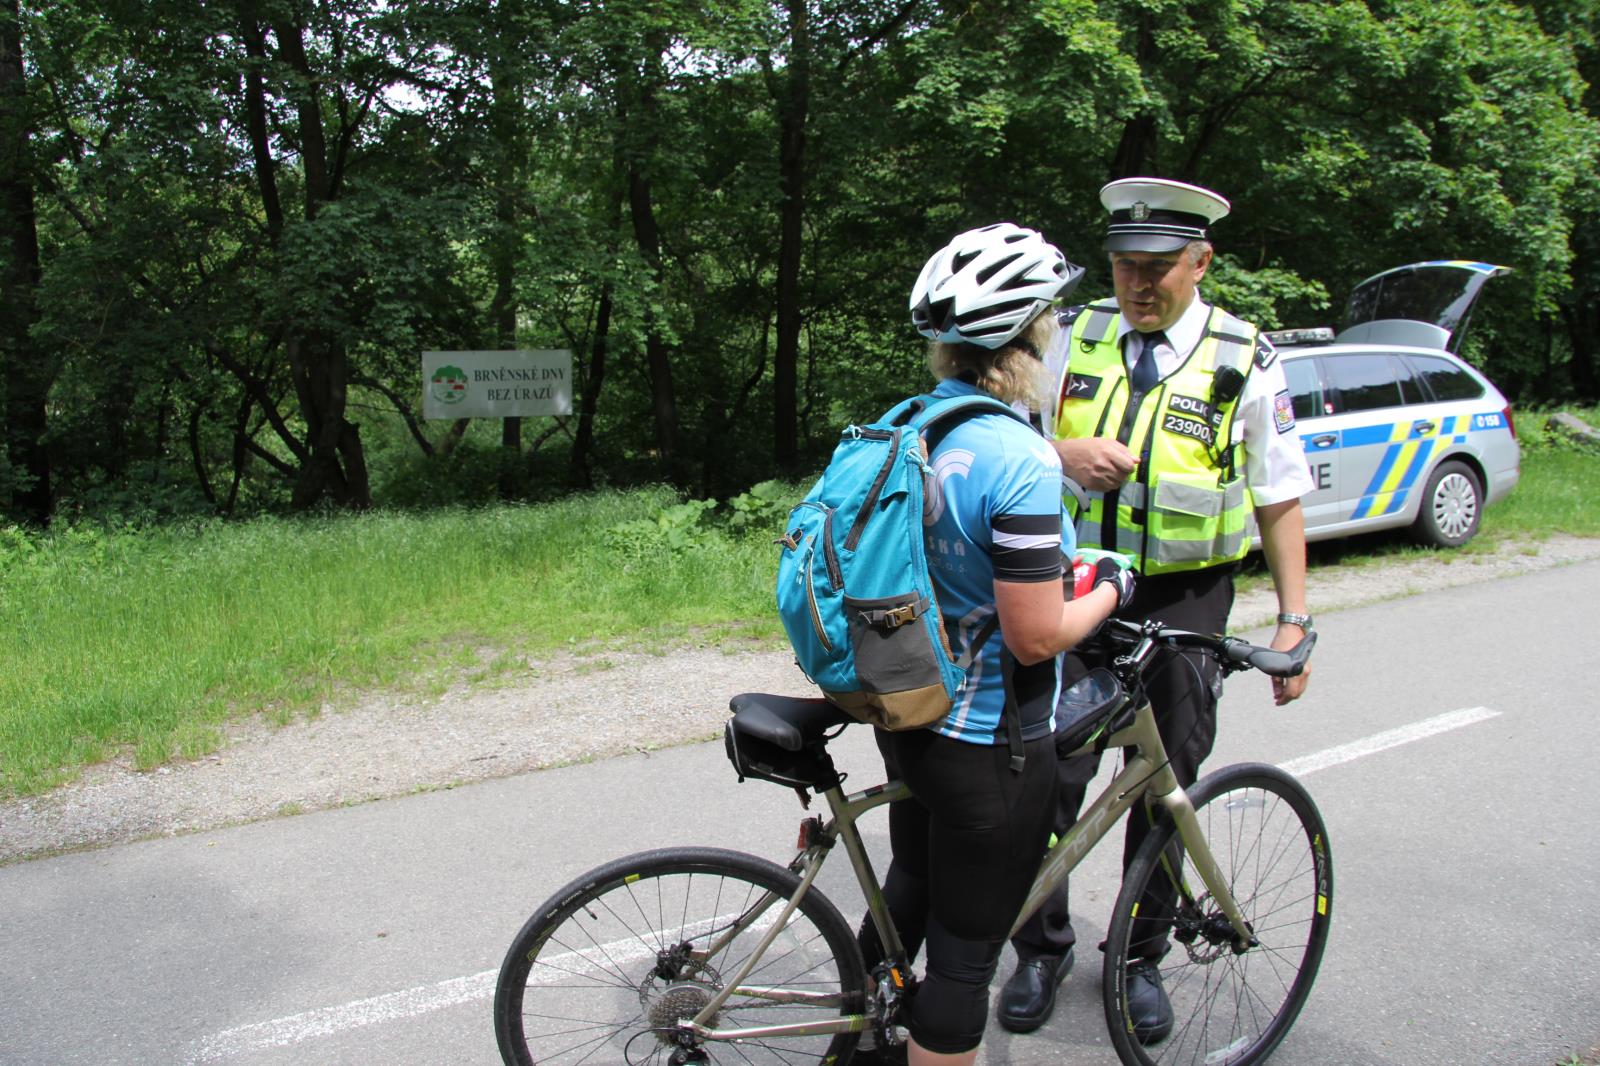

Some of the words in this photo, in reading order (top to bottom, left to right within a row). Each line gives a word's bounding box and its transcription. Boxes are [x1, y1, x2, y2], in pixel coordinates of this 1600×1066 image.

[474, 366, 537, 382] BRNĚNSKÉ
[542, 368, 566, 380] DNY
[488, 388, 510, 401] BEZ
